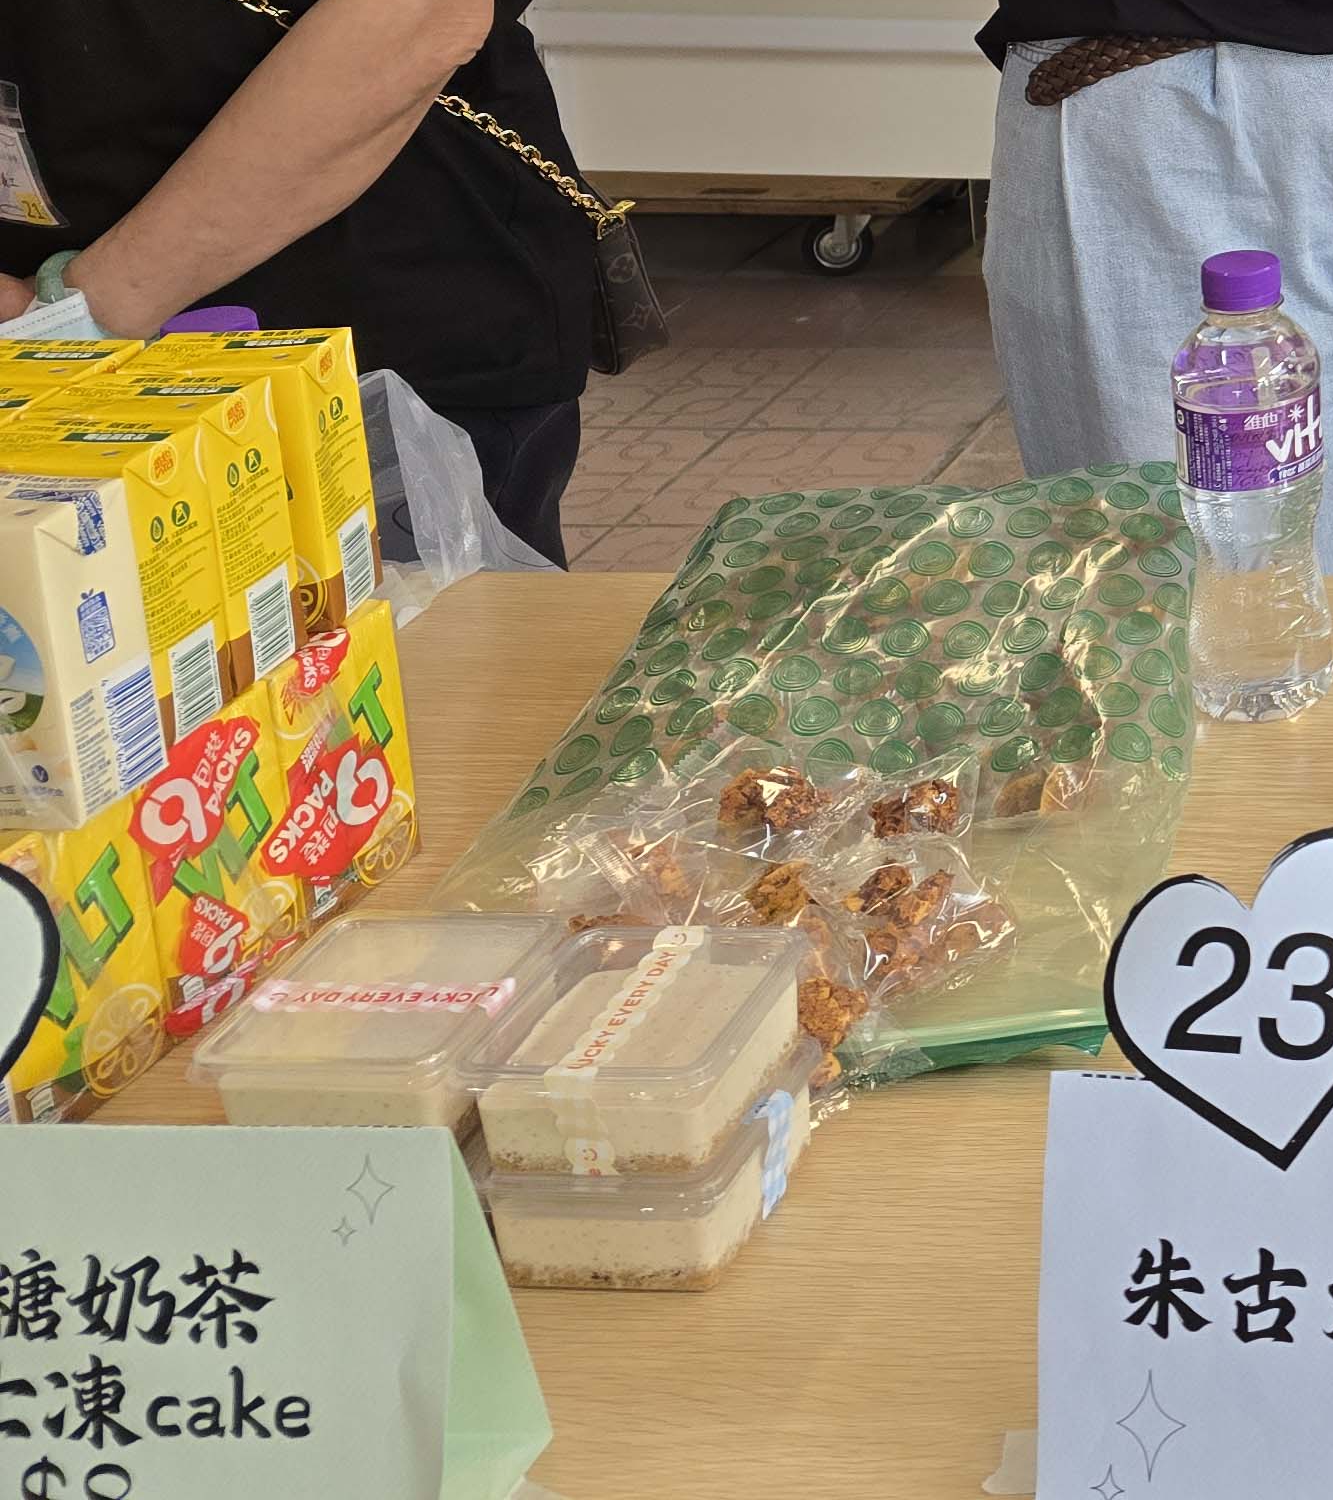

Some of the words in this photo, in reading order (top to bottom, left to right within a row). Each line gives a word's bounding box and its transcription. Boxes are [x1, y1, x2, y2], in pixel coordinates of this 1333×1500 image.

[205, 727, 252, 817] PACKS
[140, 777, 208, 845] 9
[268, 771, 335, 864] PACKS
[193, 896, 235, 928] PACKS
[294, 990, 338, 1003] DAY
[342, 991, 421, 1004] EVERY
[424, 985, 500, 1004] LUCKY
[567, 1030, 615, 1070] LUCKY
[608, 979, 655, 1028] EVERY
[647, 950, 677, 978] DAY
[0, 1249, 276, 1349] 糖奶茶
